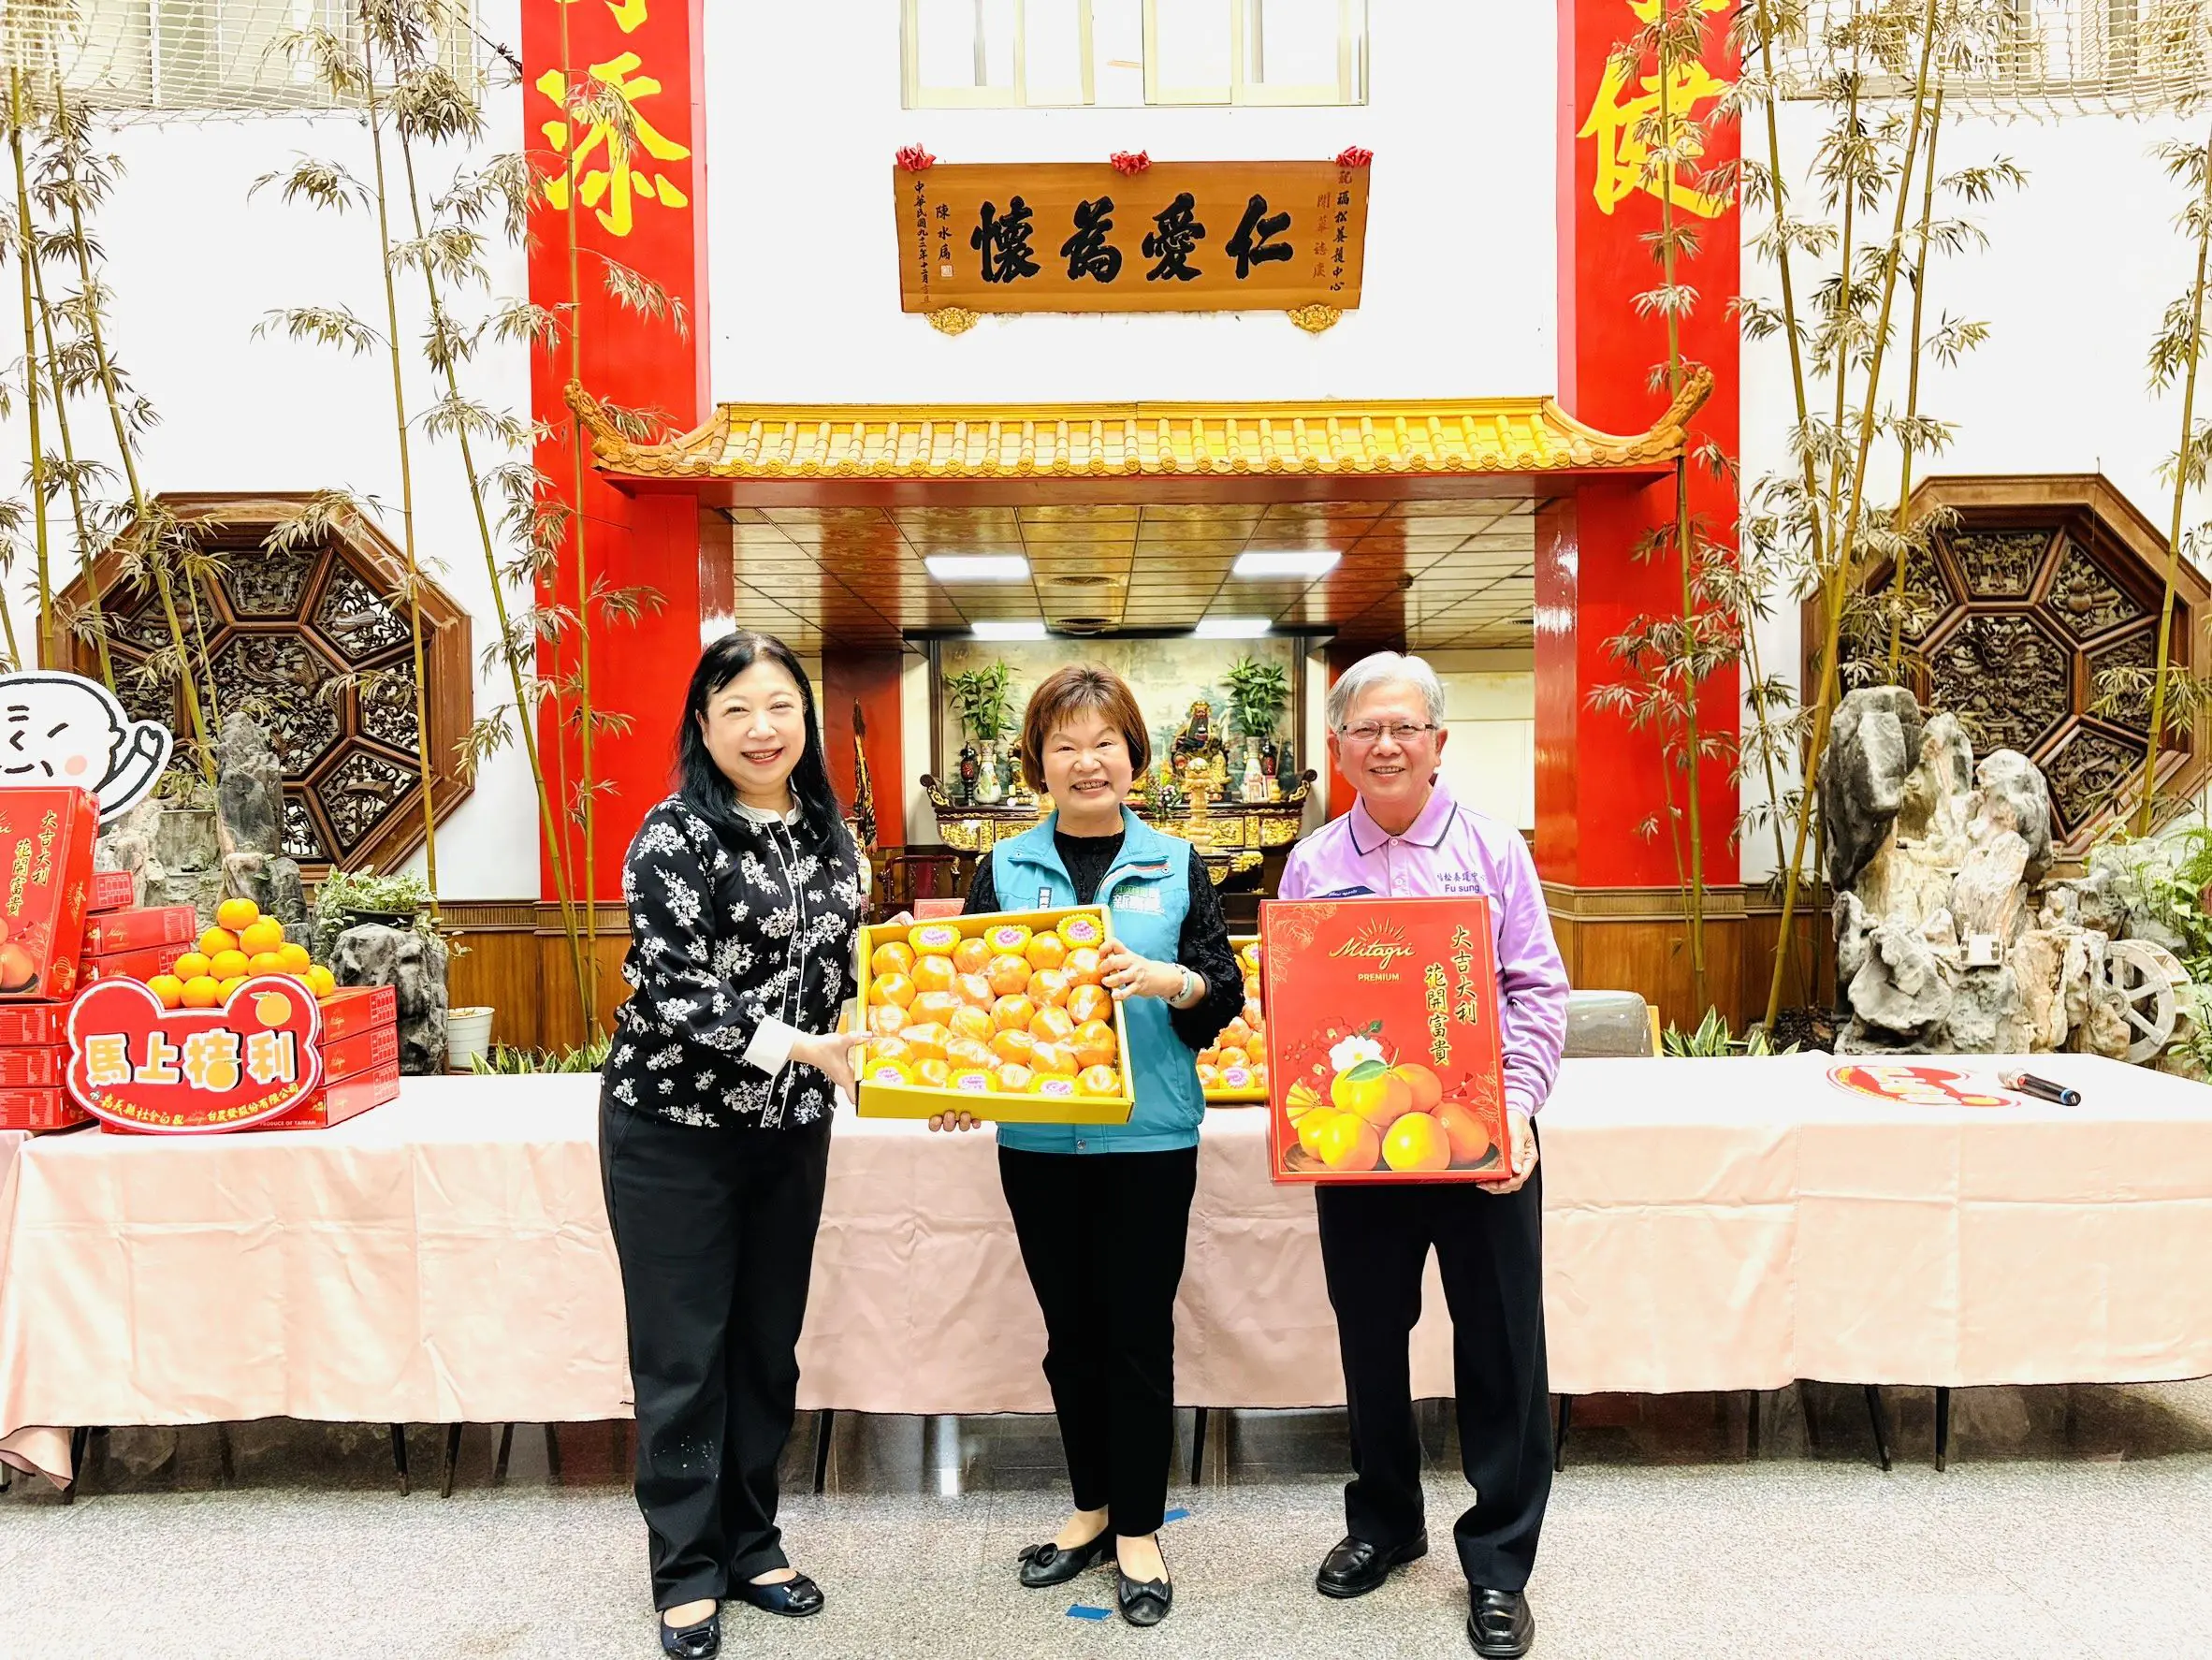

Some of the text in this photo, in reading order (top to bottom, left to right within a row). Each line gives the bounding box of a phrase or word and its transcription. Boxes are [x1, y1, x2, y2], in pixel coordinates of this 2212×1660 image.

[535, 0, 691, 237] 添
[1576, 0, 1738, 218] 健
[936, 203, 953, 261] 陳水扁
[7, 838, 32, 917] 花開富貴
[32, 809, 58, 887] 大吉大利
[1445, 884, 1480, 893] Fu sung
[1358, 973, 1400, 982] PREMIUM
[1451, 925, 1477, 1025] 大吉大利
[1424, 963, 1451, 1067] 花開富貴
